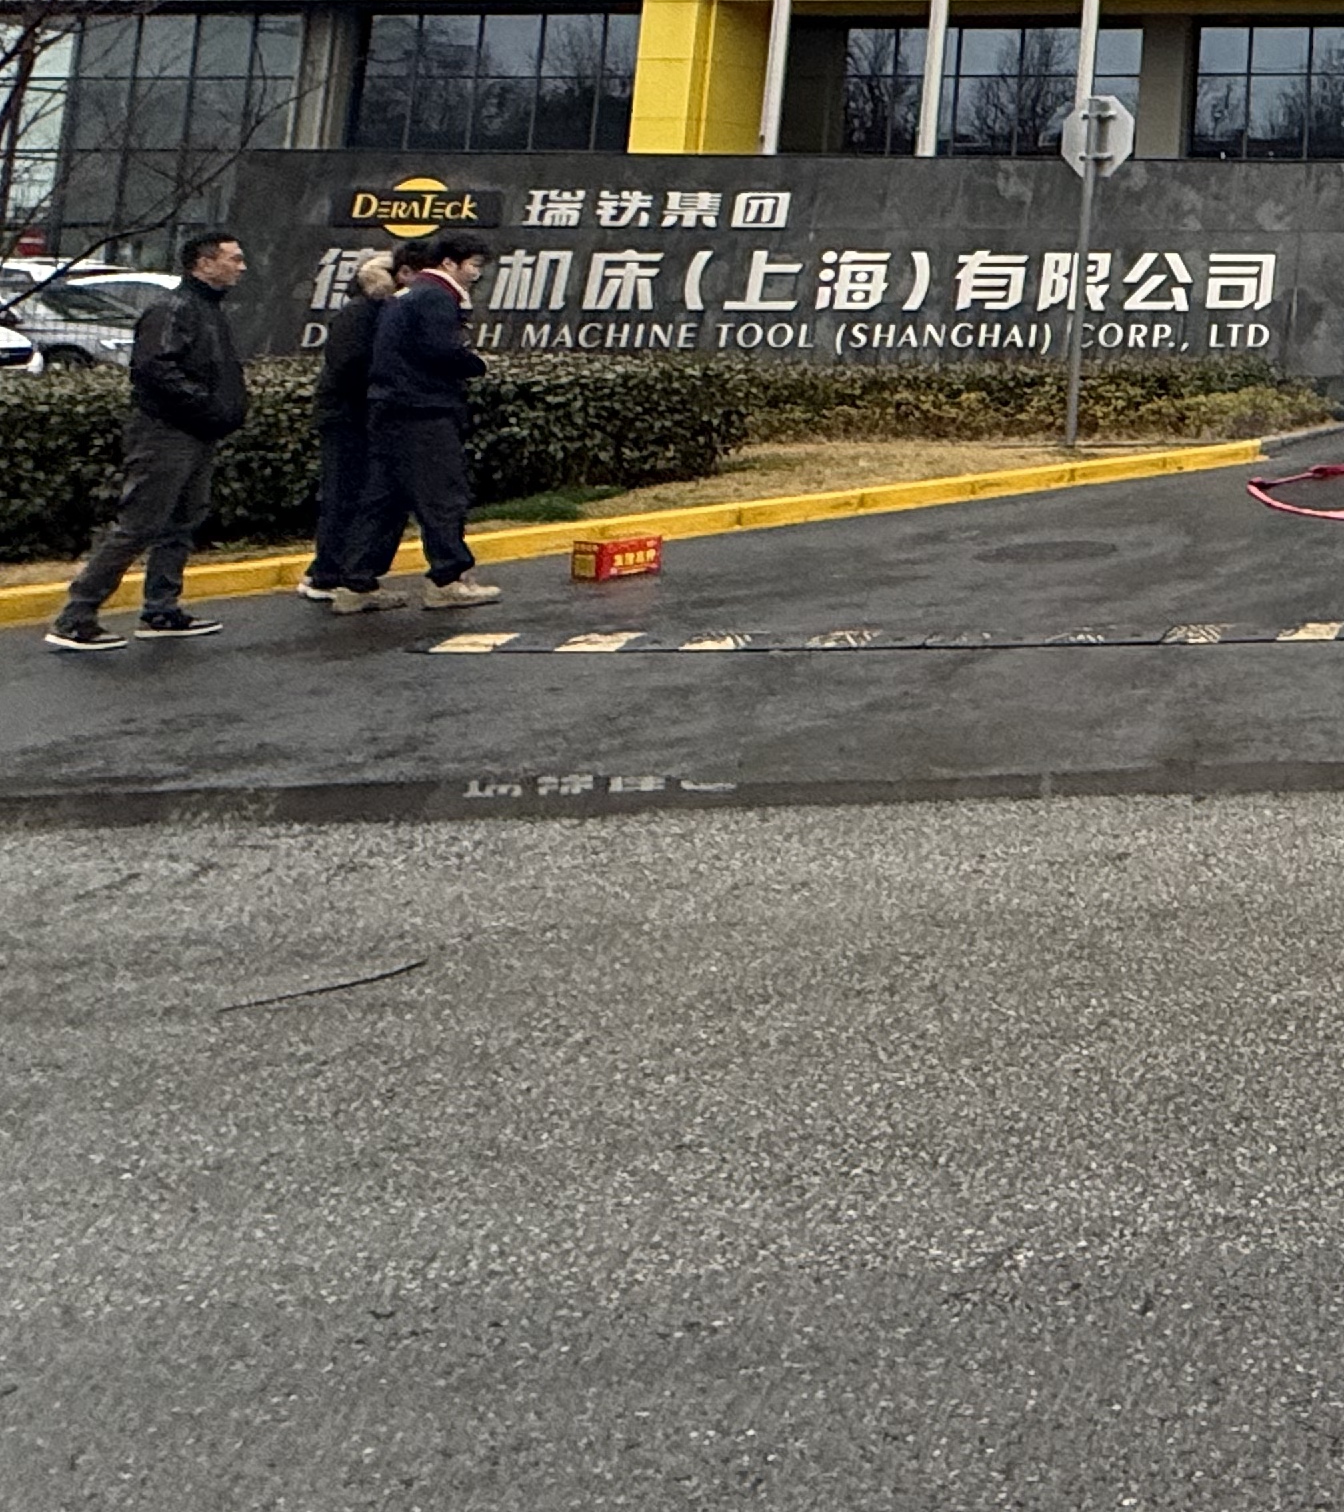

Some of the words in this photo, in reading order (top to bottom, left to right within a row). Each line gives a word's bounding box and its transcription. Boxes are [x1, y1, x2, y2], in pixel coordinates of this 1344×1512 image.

[521, 189, 792, 229] 瑞铁集团
[310, 248, 1277, 312] 德机床（上海）有限公司
[520, 322, 699, 349] MACHINE
[715, 322, 814, 349] TOOL
[834, 322, 1052, 356] (SHANGHAI)
[1208, 323, 1271, 348] LTD
